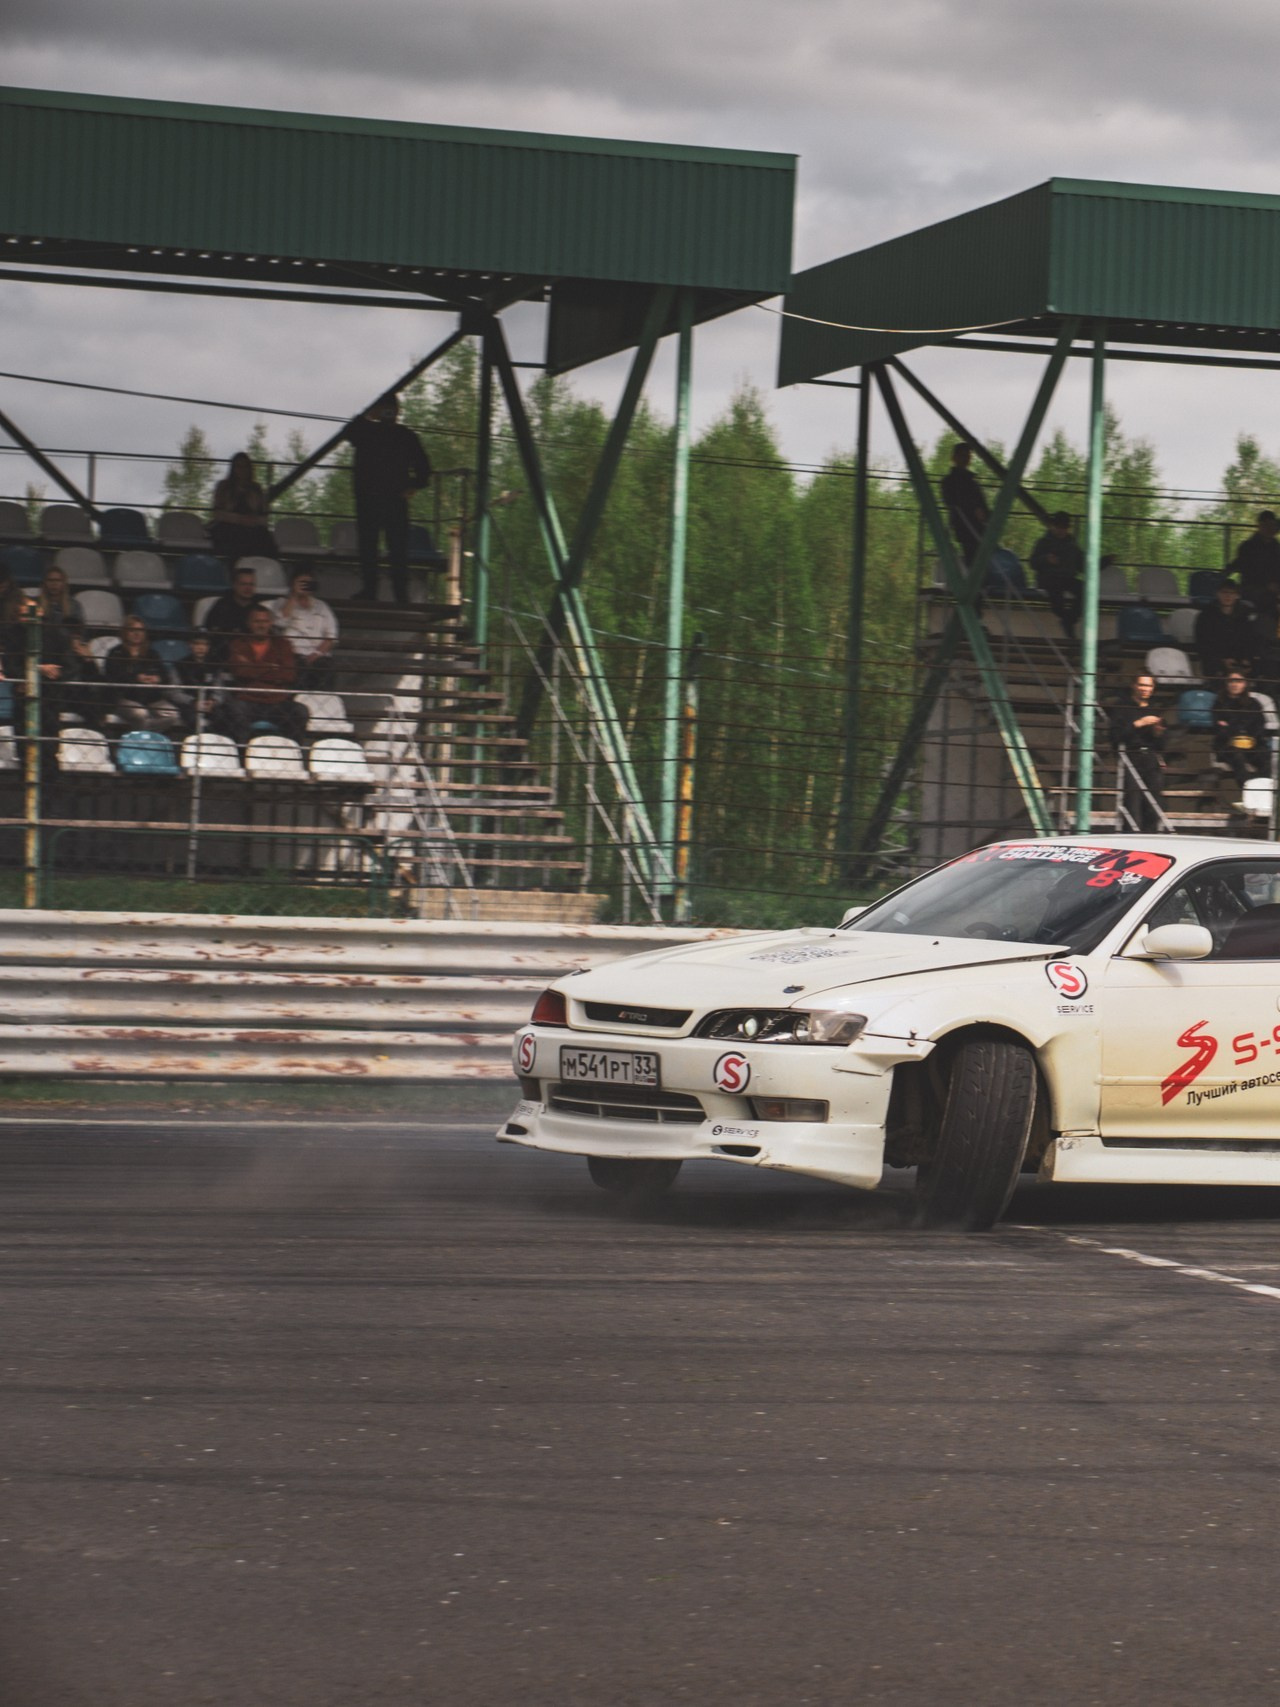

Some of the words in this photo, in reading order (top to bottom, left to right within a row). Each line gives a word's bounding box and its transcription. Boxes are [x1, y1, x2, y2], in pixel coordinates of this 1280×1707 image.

[998, 850, 1096, 864] CHALLENGE
[634, 1055, 653, 1075] 33
[1186, 1079, 1238, 1106] Лучший
